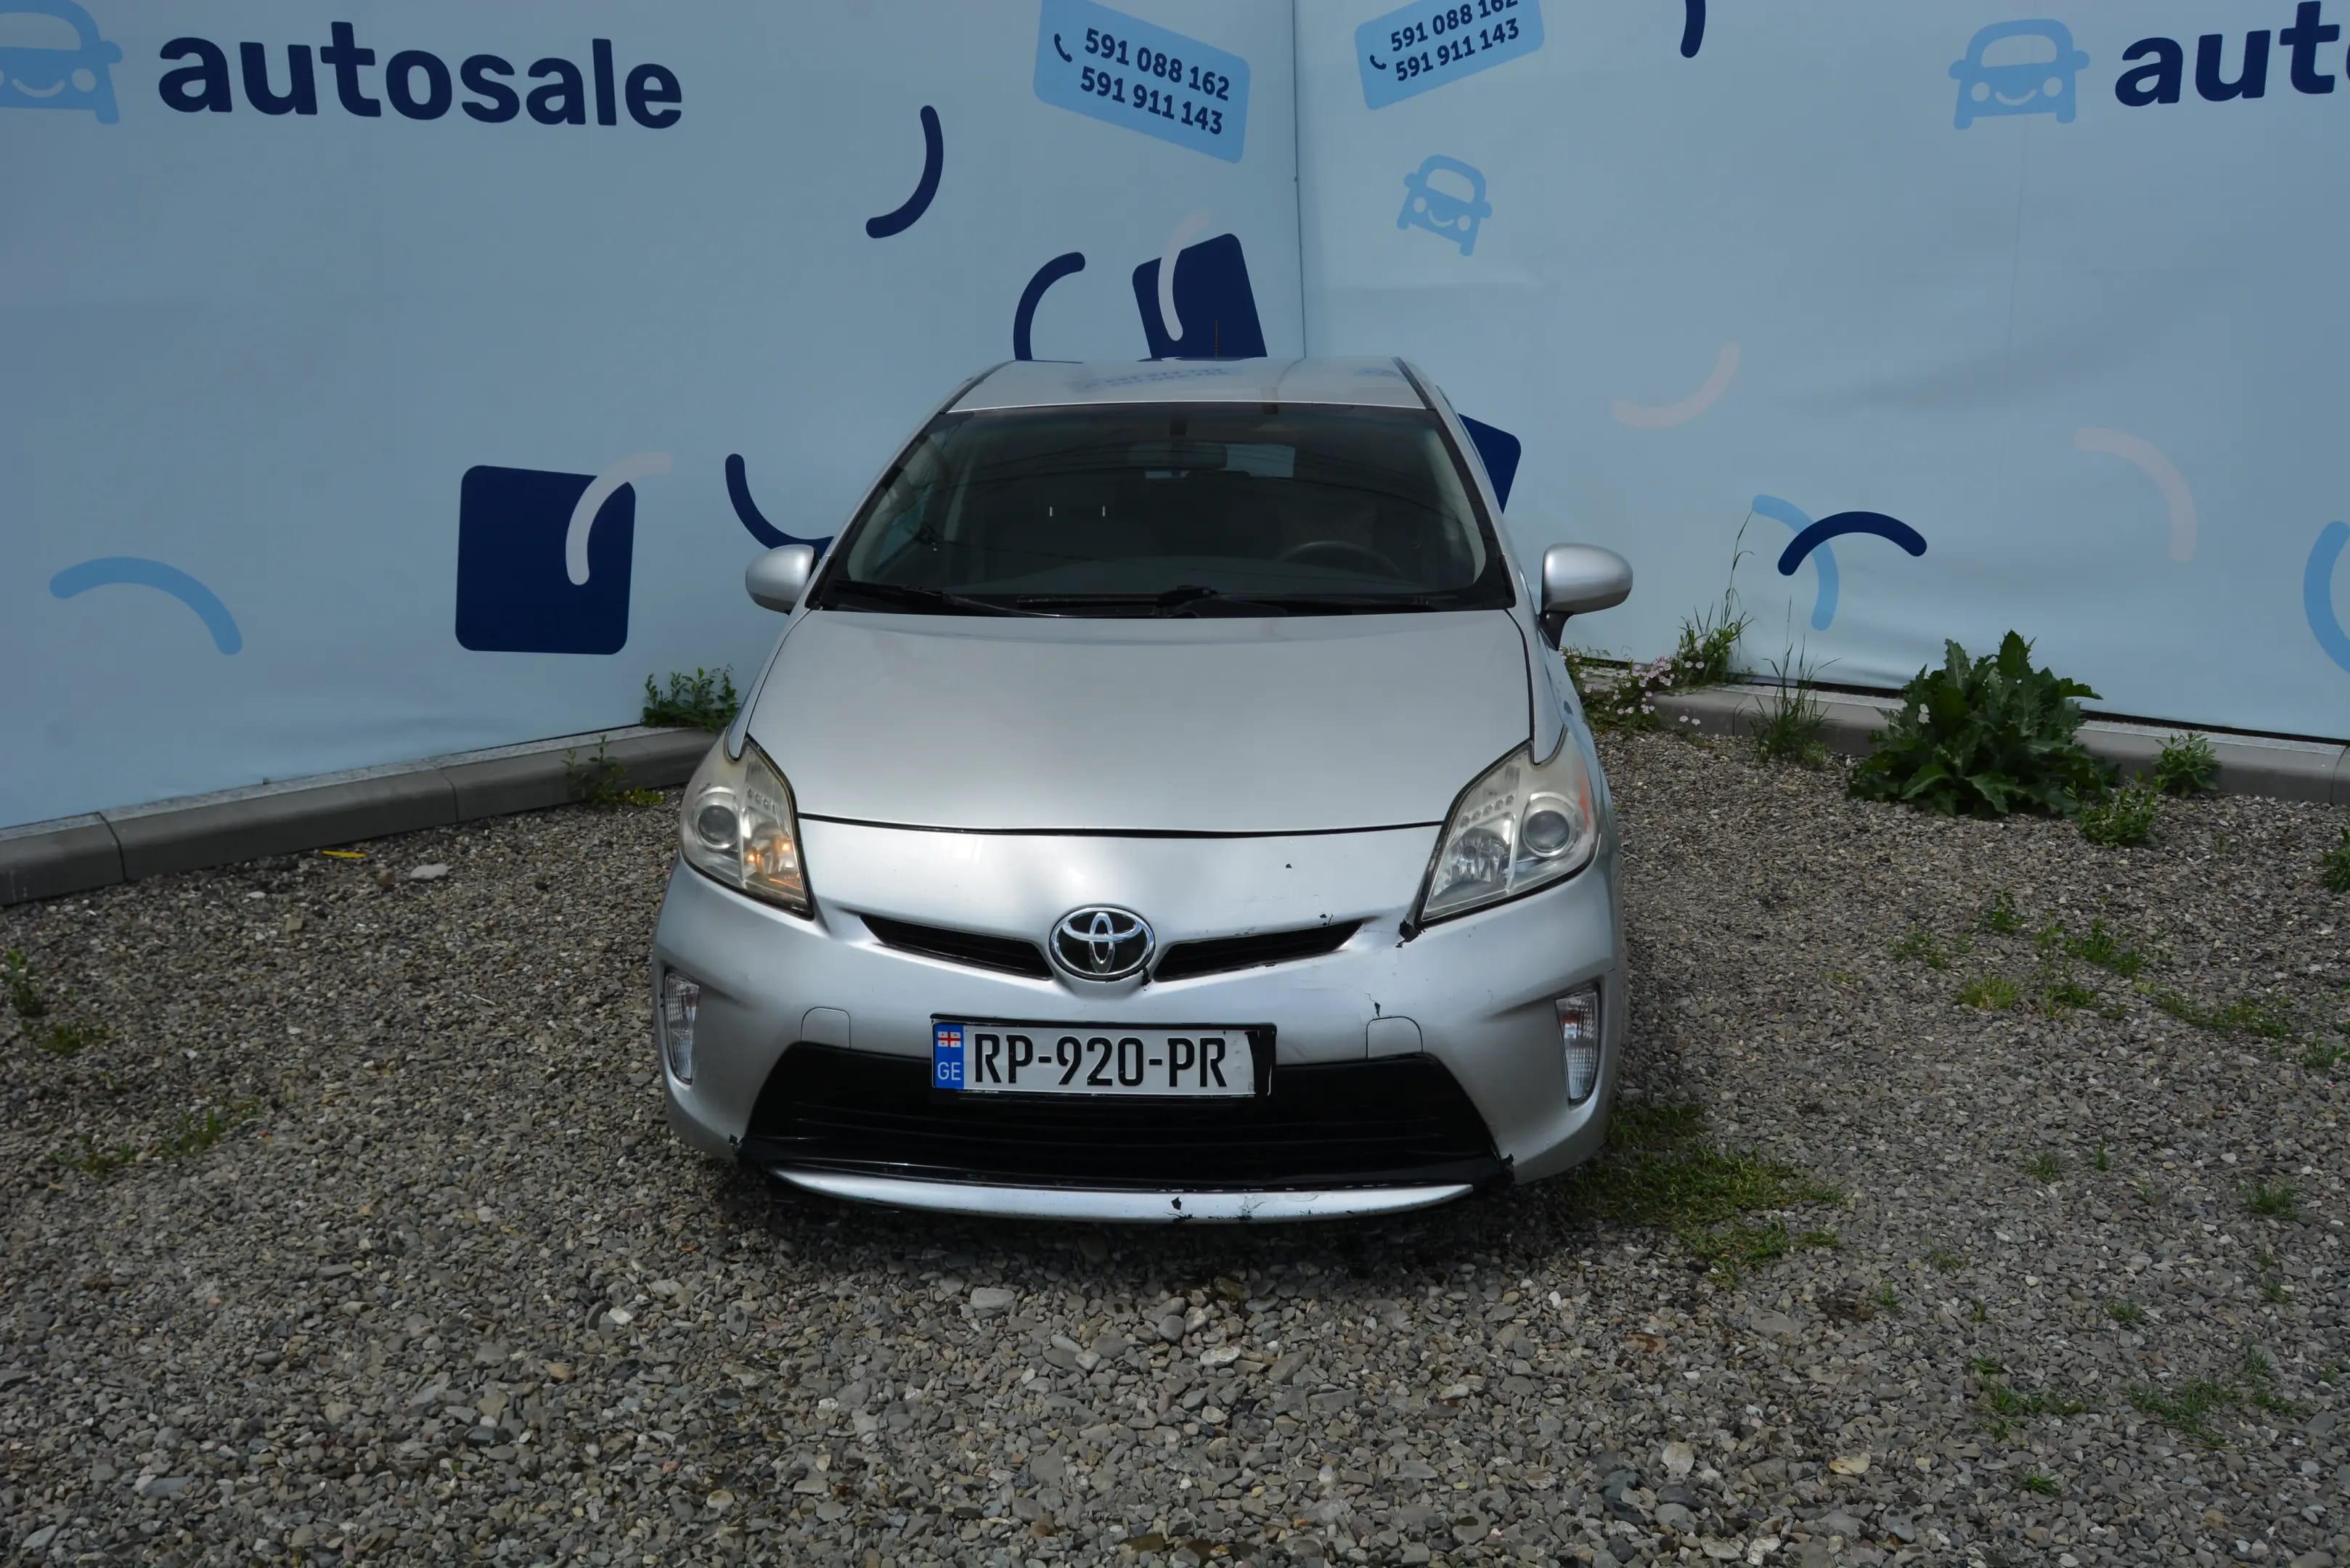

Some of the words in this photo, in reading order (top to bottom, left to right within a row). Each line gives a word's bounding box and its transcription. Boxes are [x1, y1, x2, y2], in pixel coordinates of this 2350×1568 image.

[1390, 21, 1429, 52] 591
[1432, 4, 1474, 36] 088
[1395, 51, 1435, 82] 591
[1436, 35, 1477, 67] 911
[1478, 17, 1520, 51] 143
[2114, 0, 2350, 107] aut
[158, 21, 682, 129] autosale
[1084, 27, 1130, 67] 591
[1136, 46, 1183, 83] 088
[1188, 65, 1231, 102] 162
[1080, 65, 1126, 105] 591
[1132, 83, 1175, 121] 911
[1180, 100, 1223, 136] 143
[937, 1061, 961, 1081] GE
[974, 1033, 1228, 1088] RP-920-PR
